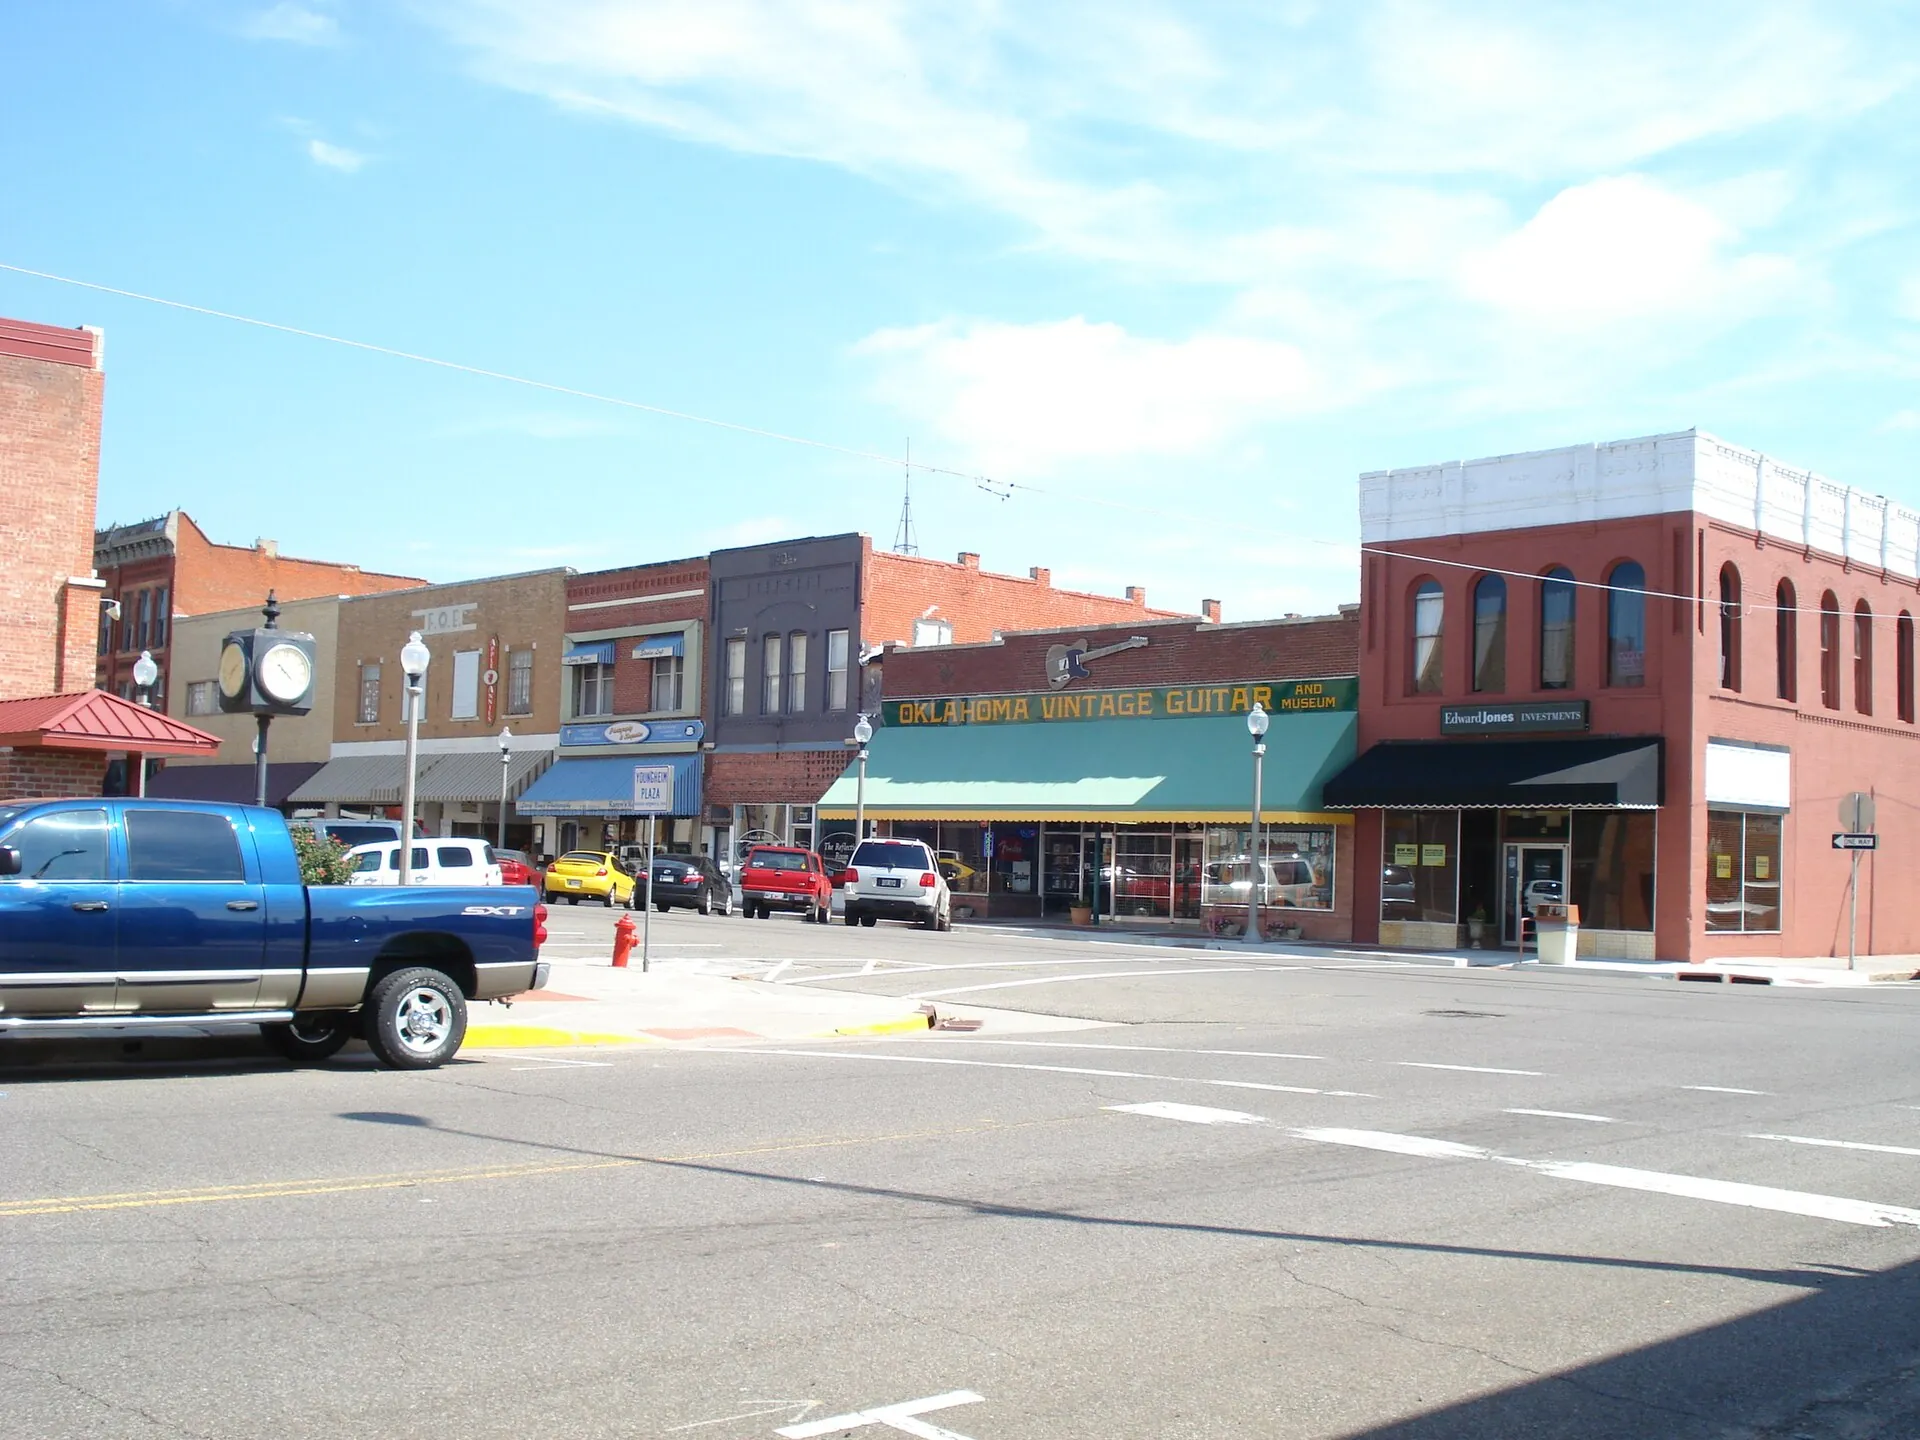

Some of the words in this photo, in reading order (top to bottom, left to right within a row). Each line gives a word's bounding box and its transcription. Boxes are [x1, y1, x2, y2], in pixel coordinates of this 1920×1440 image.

[1294, 683, 1323, 695] AND
[899, 697, 1030, 725] OKLAHOMA
[1041, 691, 1153, 719] VINTAGE
[1166, 686, 1273, 715] GUITAR
[1281, 696, 1337, 709] MUSEUM
[1521, 711, 1582, 722] INVESTMENTS
[641, 787, 661, 800] PLAZA
[824, 842, 834, 851] The
[835, 842, 856, 854] Reflecti
[461, 906, 525, 916] SXT
